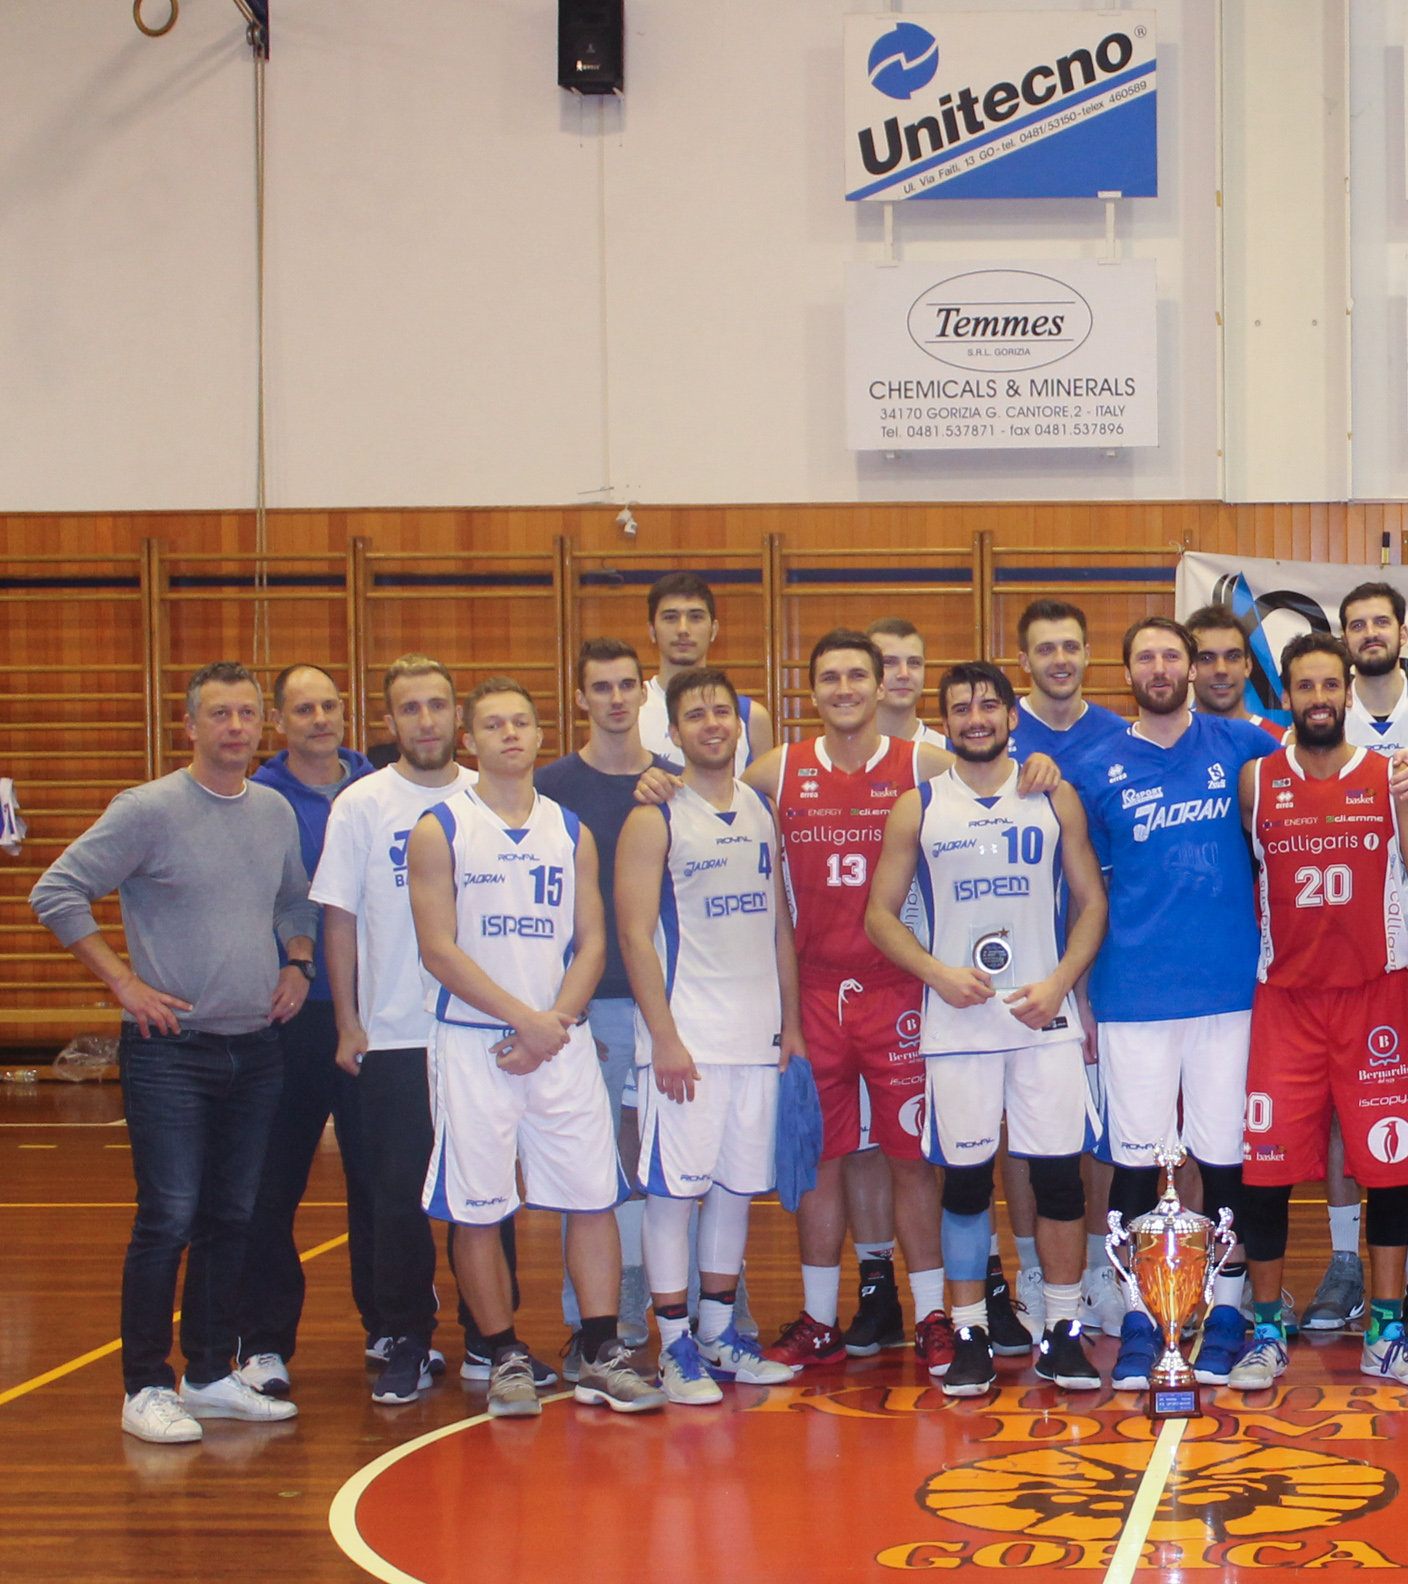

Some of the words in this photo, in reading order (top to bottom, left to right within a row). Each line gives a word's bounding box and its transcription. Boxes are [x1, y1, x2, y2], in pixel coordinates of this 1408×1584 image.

[858, 32, 1133, 176] Unitecno
[919, 172, 936, 188] Via
[965, 156, 976, 168] 13
[1108, 80, 1148, 105] 460589
[935, 307, 1065, 338] Temmes
[994, 347, 1031, 357] GORIZIA
[869, 379, 998, 400] CHEMICALS
[1005, 379, 1021, 398] &
[1030, 377, 1136, 397] MINERALS
[880, 407, 922, 420] 34170
[926, 407, 981, 420] GORIZIA
[985, 406, 1000, 419] G.
[1095, 405, 1126, 418] ITALY
[881, 426, 901, 438] Tel.
[906, 425, 995, 438] 0481.537871
[1009, 424, 1030, 436] fax
[1034, 423, 1124, 436] 0481.537896
[870, 786, 898, 798] basket
[1346, 794, 1375, 805] basket
[808, 808, 842, 817] ENERGY
[1131, 797, 1232, 842] JADRAN
[1284, 816, 1318, 826] ENERGY
[790, 825, 882, 846] calligaris
[1001, 826, 1044, 865] 10
[1268, 832, 1359, 854] calligaris
[758, 842, 772, 880] 4
[827, 853, 867, 887] 13
[529, 865, 563, 907] 15
[1294, 863, 1353, 908] 20
[906, 1018, 917, 1031] B
[1378, 1034, 1389, 1048] B
[1256, 1151, 1285, 1162] basket
[970, 1412, 1396, 1442] DOM
[876, 1540, 1407, 1570] GORICA
